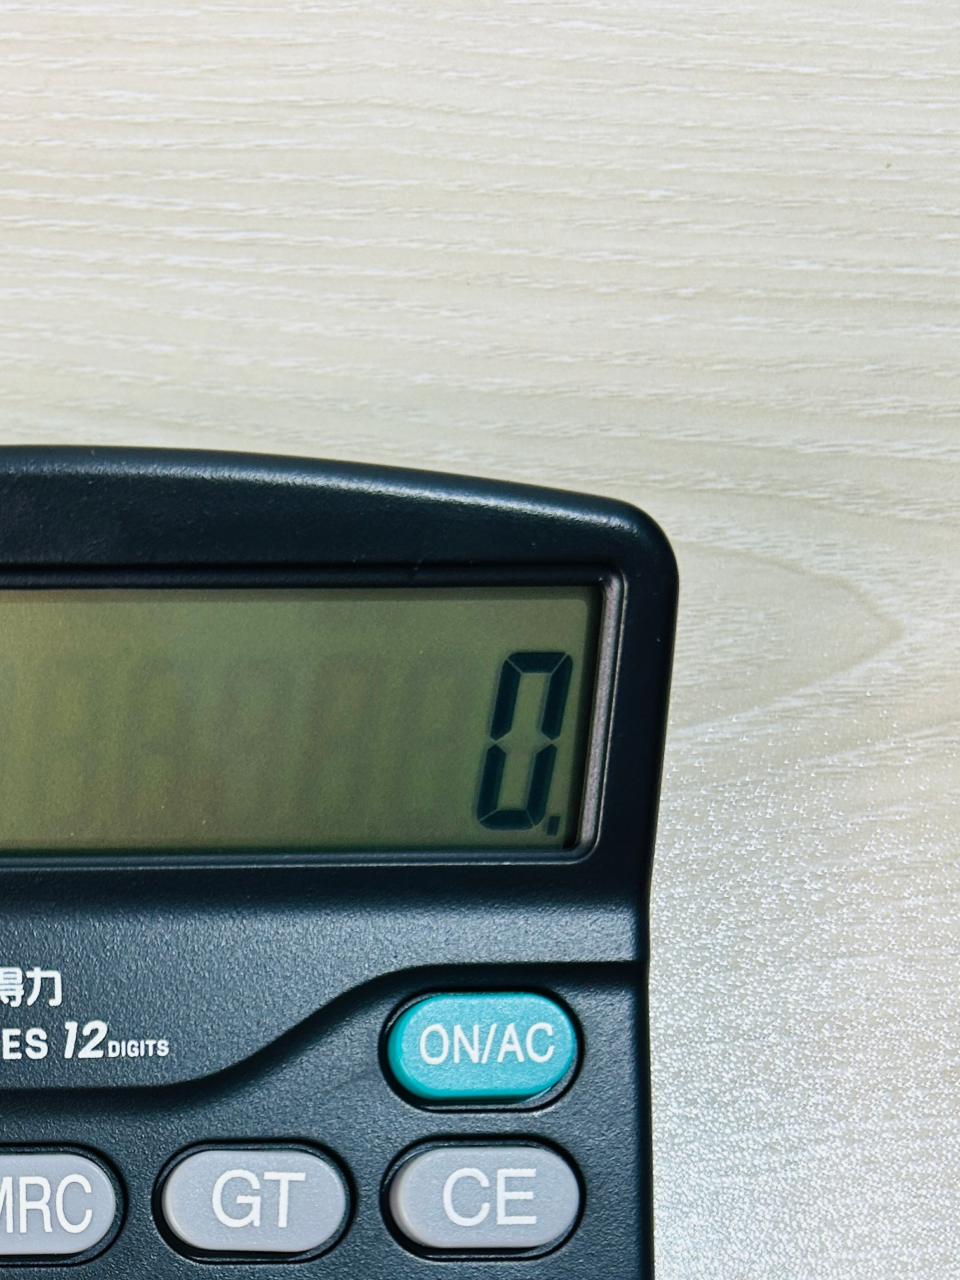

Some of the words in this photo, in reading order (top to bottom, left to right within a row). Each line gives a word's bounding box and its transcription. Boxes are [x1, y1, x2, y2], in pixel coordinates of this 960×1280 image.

[418, 1022, 556, 1066] ON/AC
[211, 1169, 307, 1229] GT
[442, 1168, 538, 1226] CE
